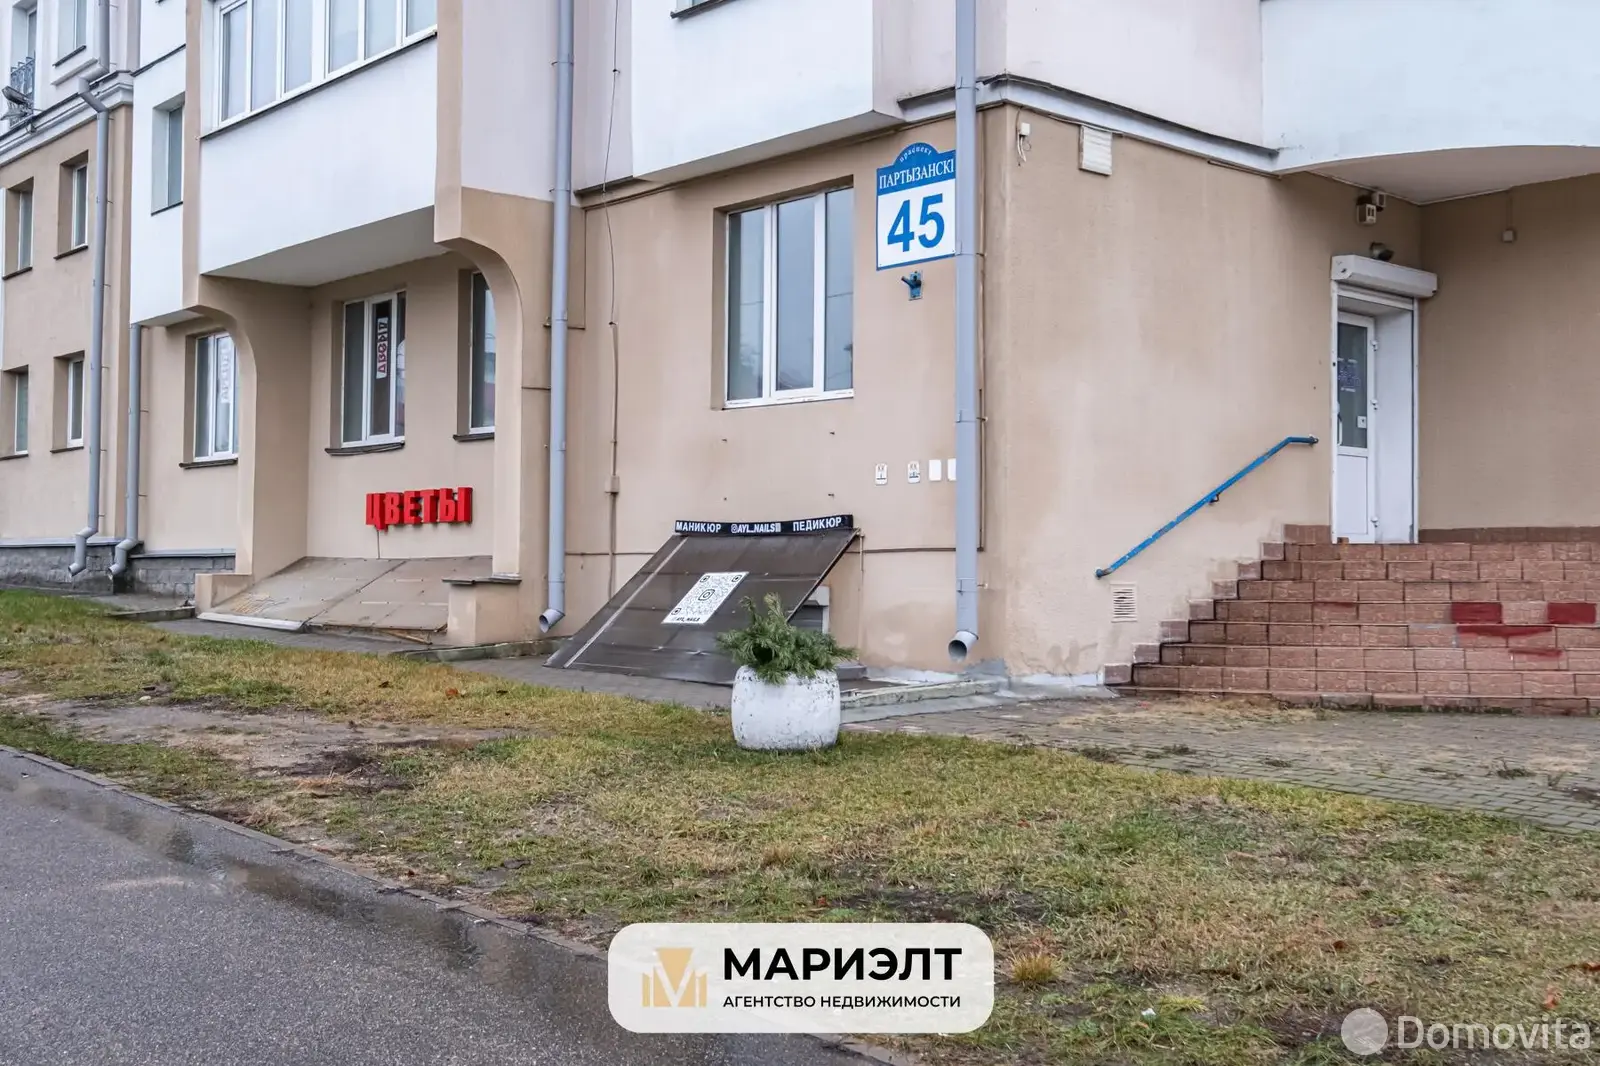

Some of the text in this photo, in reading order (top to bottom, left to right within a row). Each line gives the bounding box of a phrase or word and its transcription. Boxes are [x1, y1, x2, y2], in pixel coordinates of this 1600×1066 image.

[879, 158, 955, 189] ПАРТЫЗАНСКІ
[887, 193, 945, 253] 45
[365, 486, 473, 533] ЦВЕТЫ
[675, 520, 722, 533] МАНИКЮР
[792, 516, 842, 532] ПЕДИКЮР
